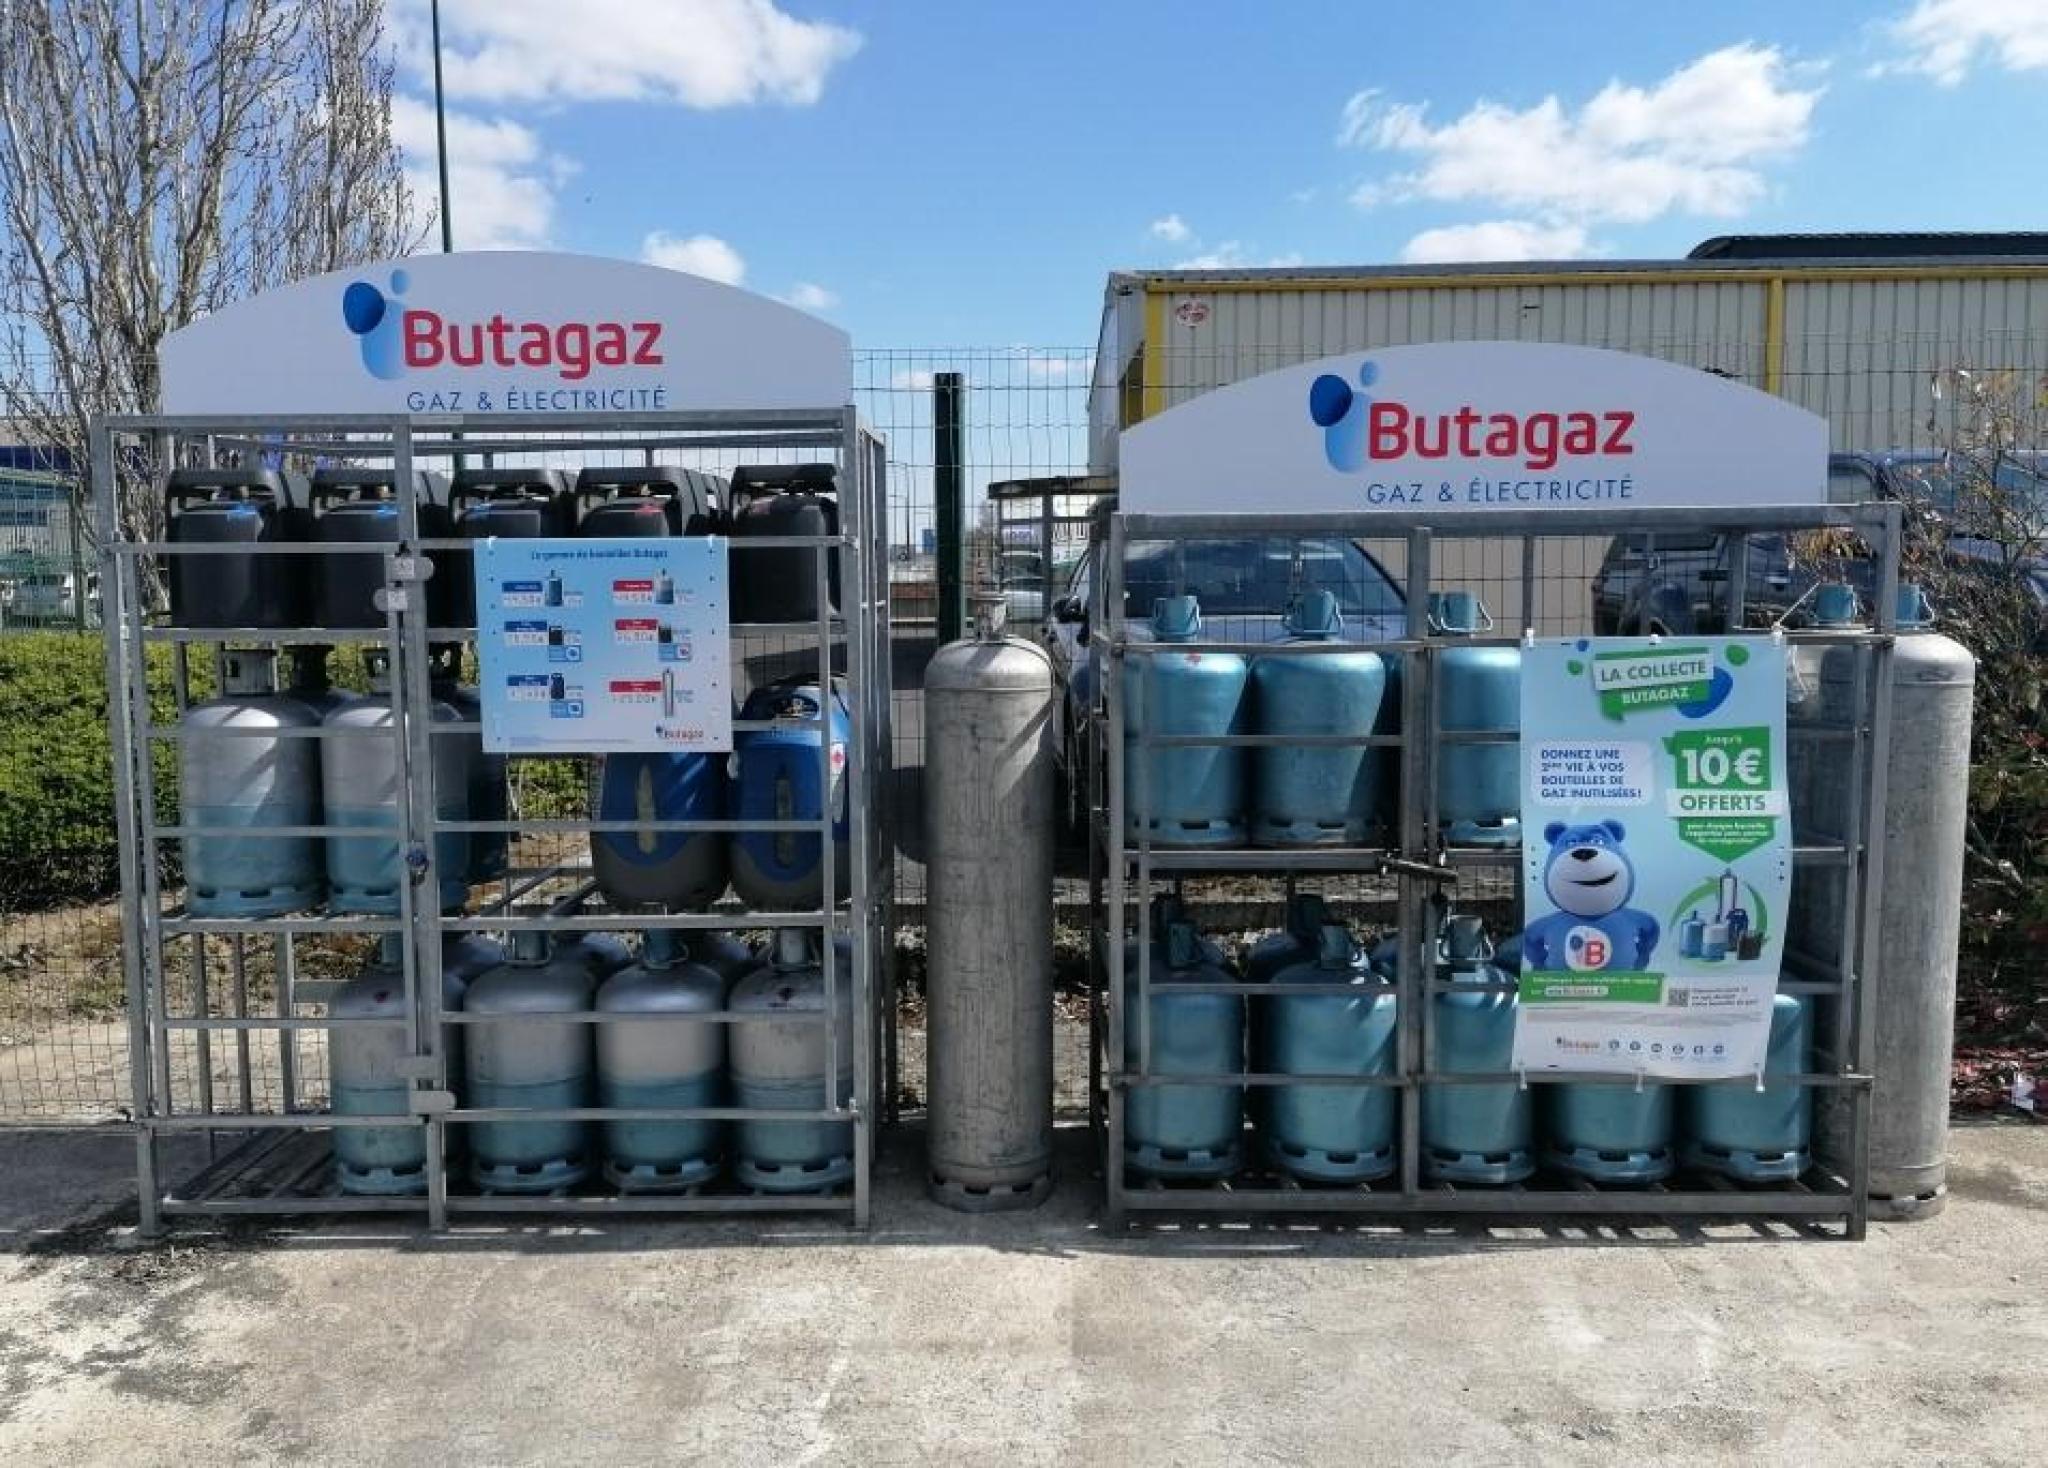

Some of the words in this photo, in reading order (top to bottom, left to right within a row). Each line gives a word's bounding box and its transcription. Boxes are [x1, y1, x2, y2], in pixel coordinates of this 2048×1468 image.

[403, 310, 664, 380] Butagaz
[406, 391, 464, 411] GAZ
[477, 391, 492, 411] &
[507, 385, 667, 410] ÉLECTRICITÉ
[1368, 402, 1635, 470] Butagaz
[1367, 483, 1424, 504] GAZ
[1438, 481, 1453, 502] &
[1468, 474, 1634, 501] ÉLECTRICITÉ
[1601, 668, 1621, 682] LA
[1627, 660, 1707, 680] COLLECTE
[1622, 687, 1690, 704] BUTAGAZ
[1541, 749, 1591, 759] DONNEZ
[1595, 749, 1620, 759] UNE
[1565, 762, 1584, 772] VIE
[1587, 760, 1596, 772] À
[1599, 762, 1625, 772] VOS
[1541, 775, 1605, 785] BOUTEILLES
[1610, 775, 1624, 785] DE
[1541, 788, 1566, 798] GAZ
[1680, 794, 1766, 811] OFFERTS
